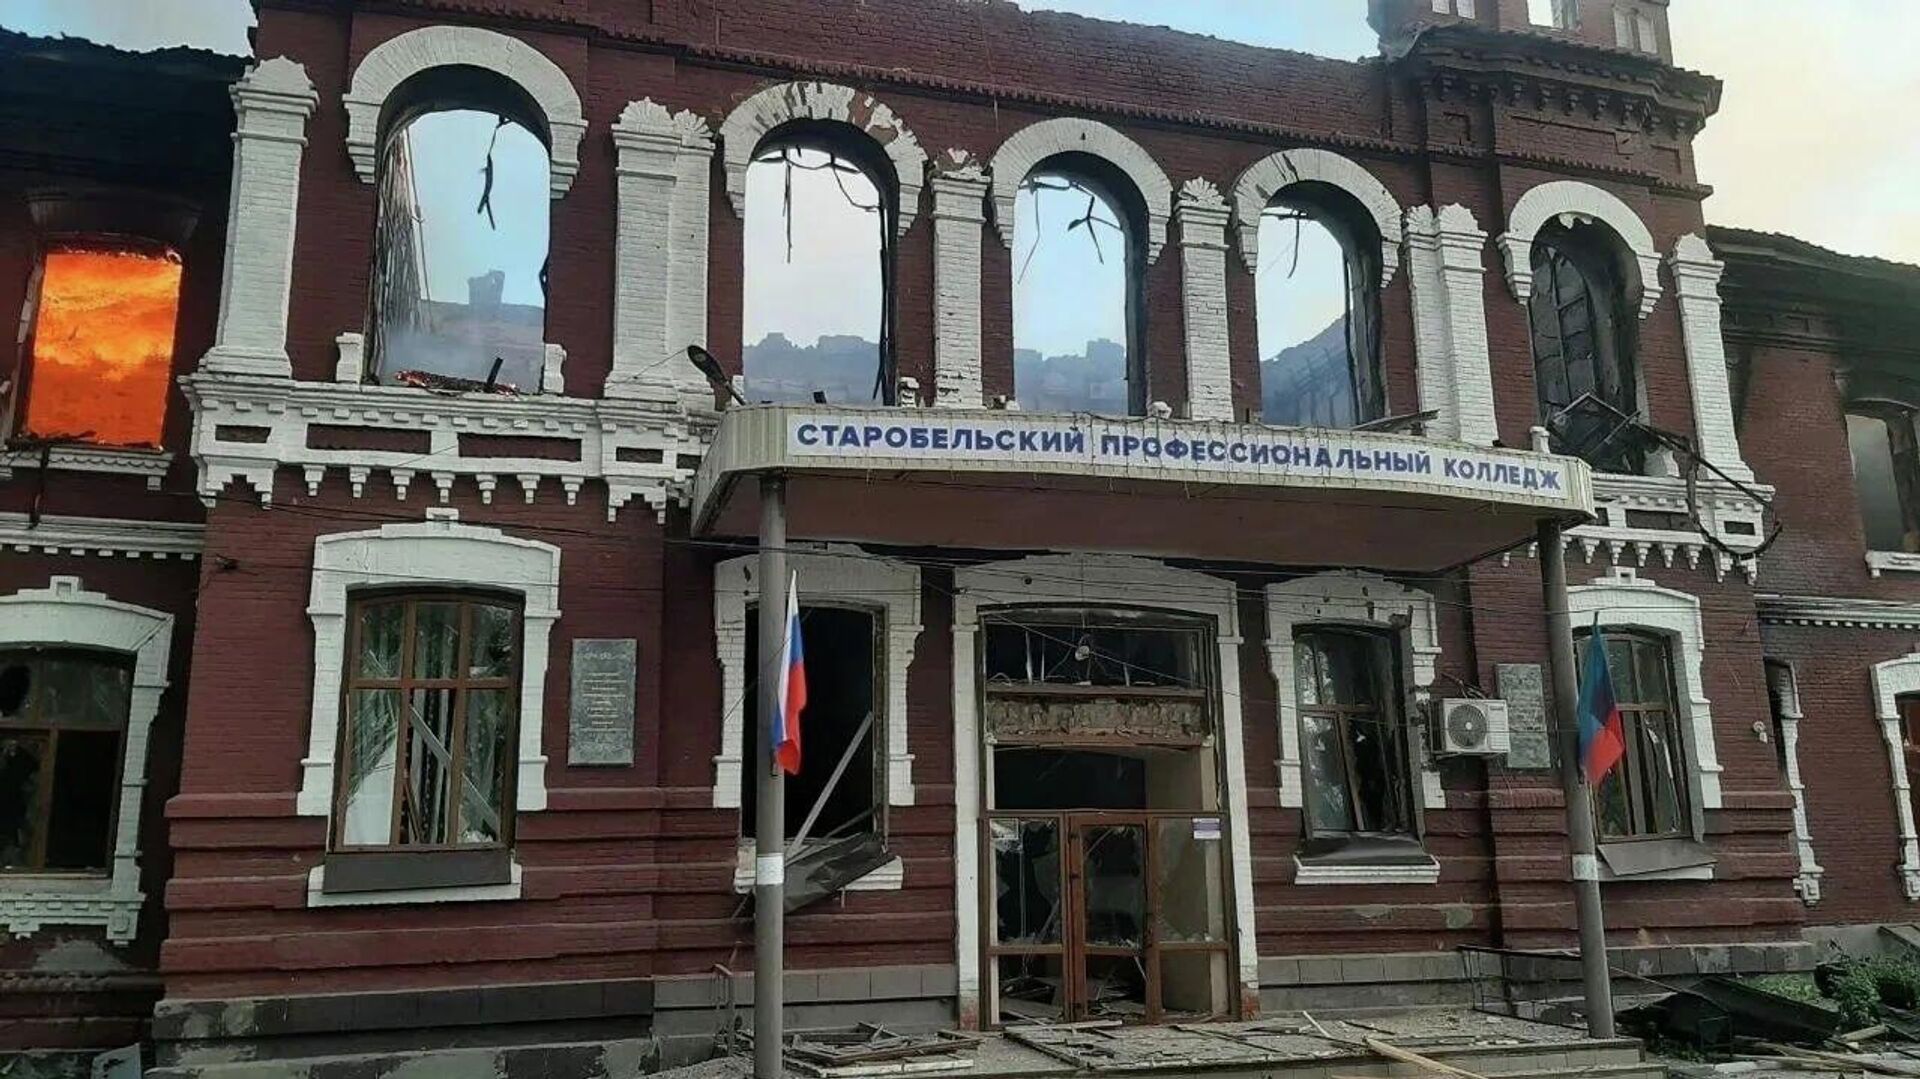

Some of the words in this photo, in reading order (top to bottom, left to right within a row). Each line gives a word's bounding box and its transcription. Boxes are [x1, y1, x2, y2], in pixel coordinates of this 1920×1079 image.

[797, 423, 1085, 452] СТАРОБЕЛЬСКИЙ
[1100, 434, 1431, 475] ПРОФЕССИОНАЛЬНЫЙ
[1443, 457, 1561, 491] КОЛЛЕДЖ
